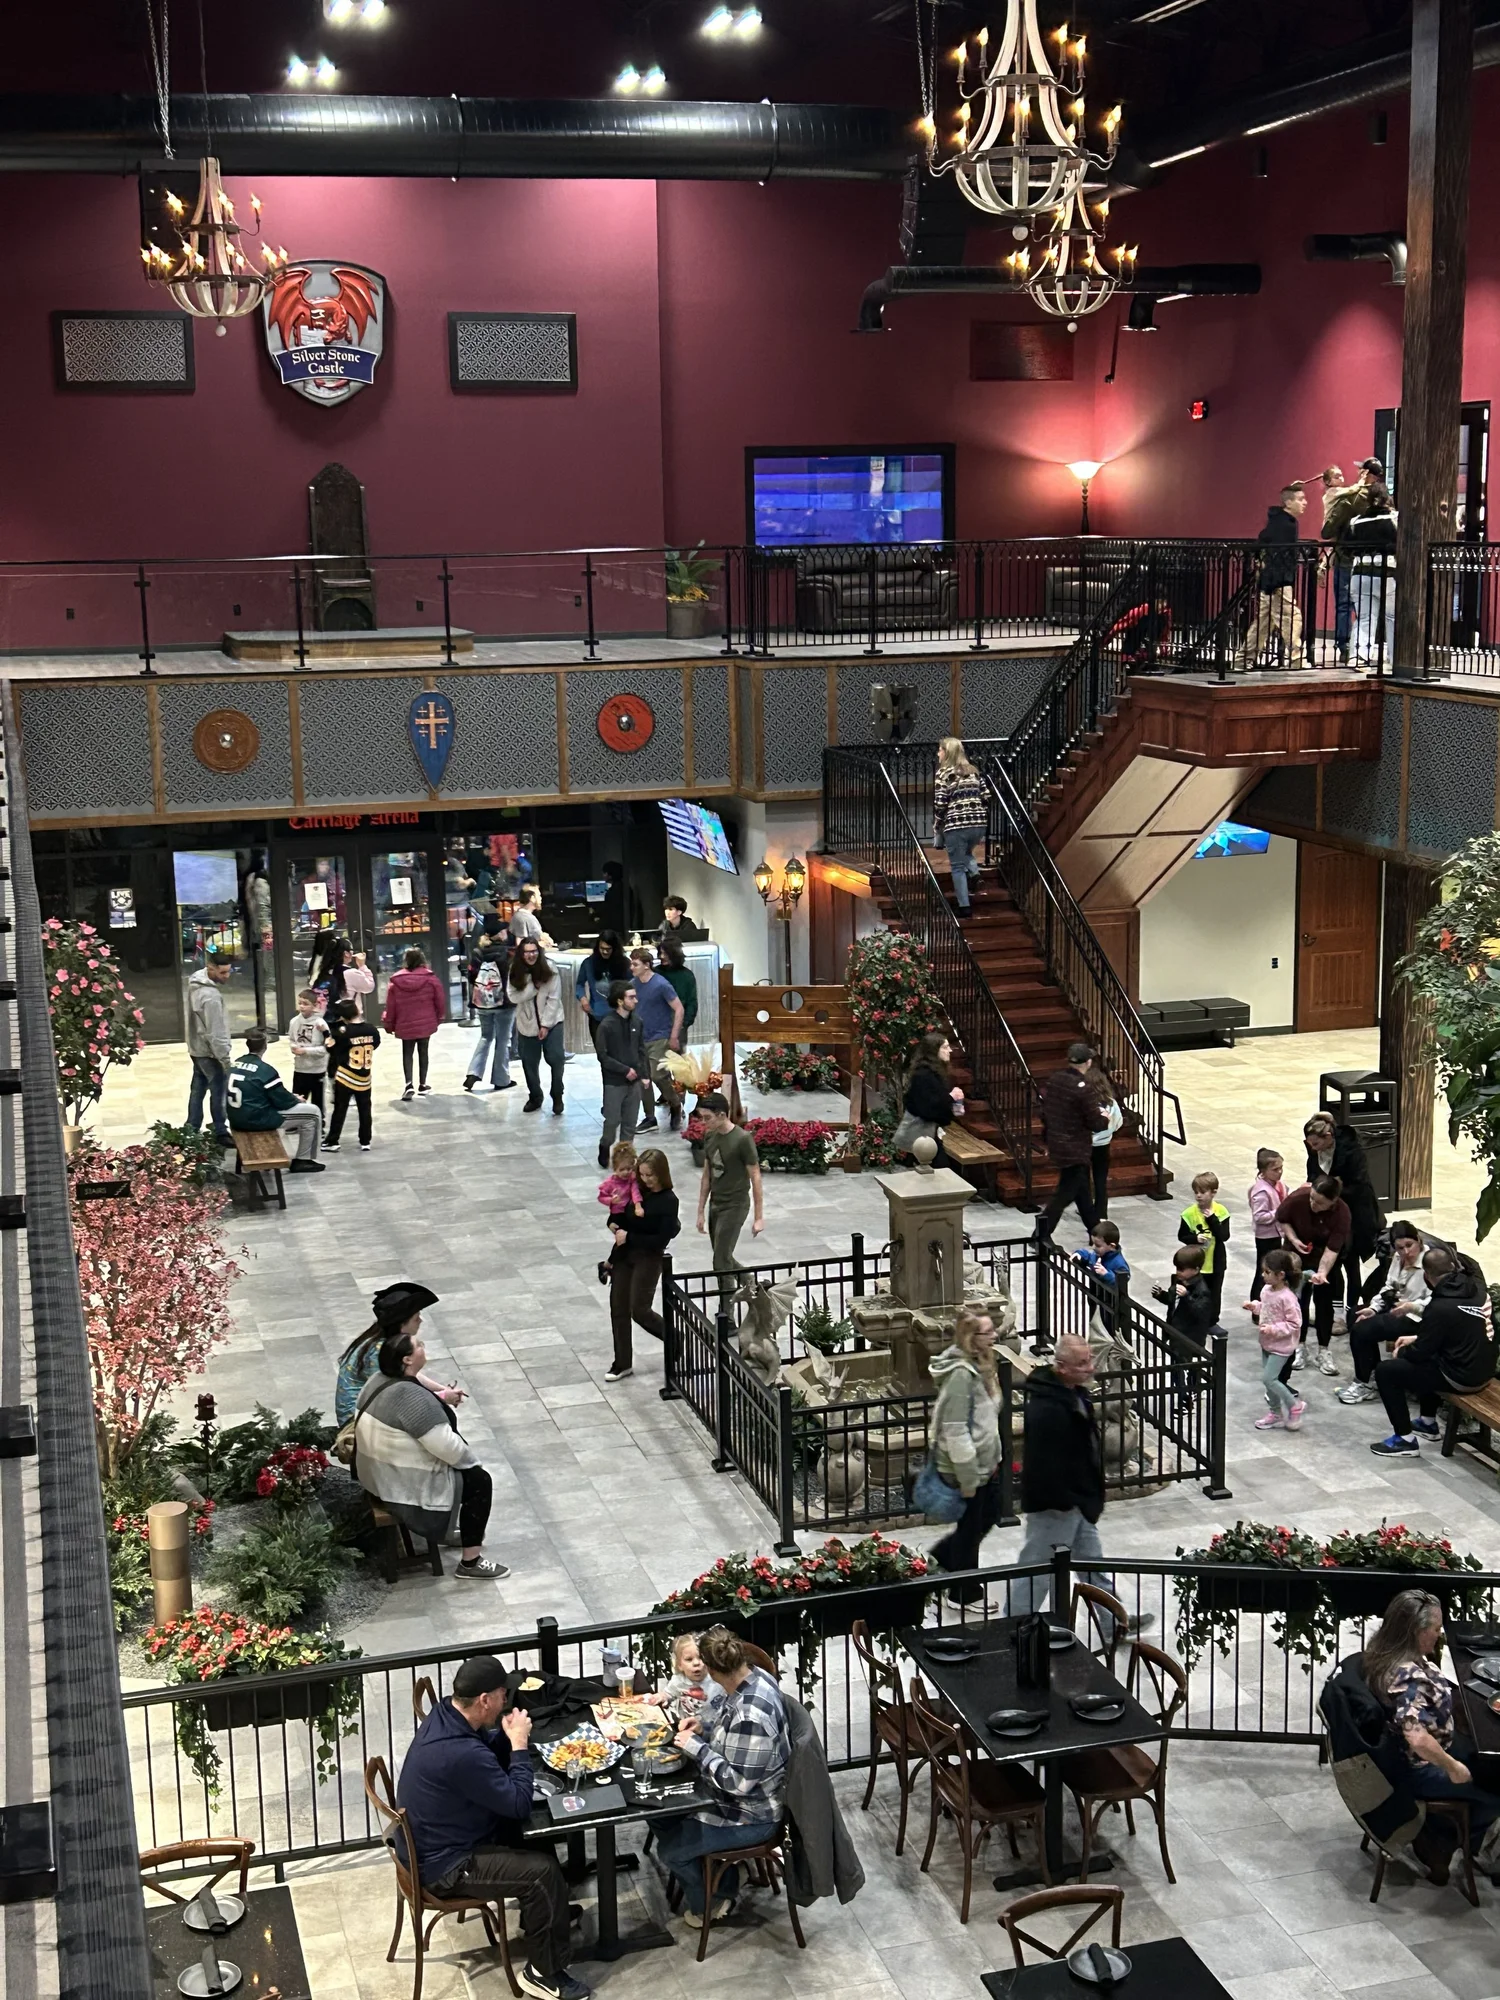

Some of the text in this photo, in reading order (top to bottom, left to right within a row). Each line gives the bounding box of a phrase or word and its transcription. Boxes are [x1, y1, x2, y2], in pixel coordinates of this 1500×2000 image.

[292, 349, 361, 364] Silver Stone
[307, 361, 345, 374] Castle
[228, 1073, 246, 1108] 5
